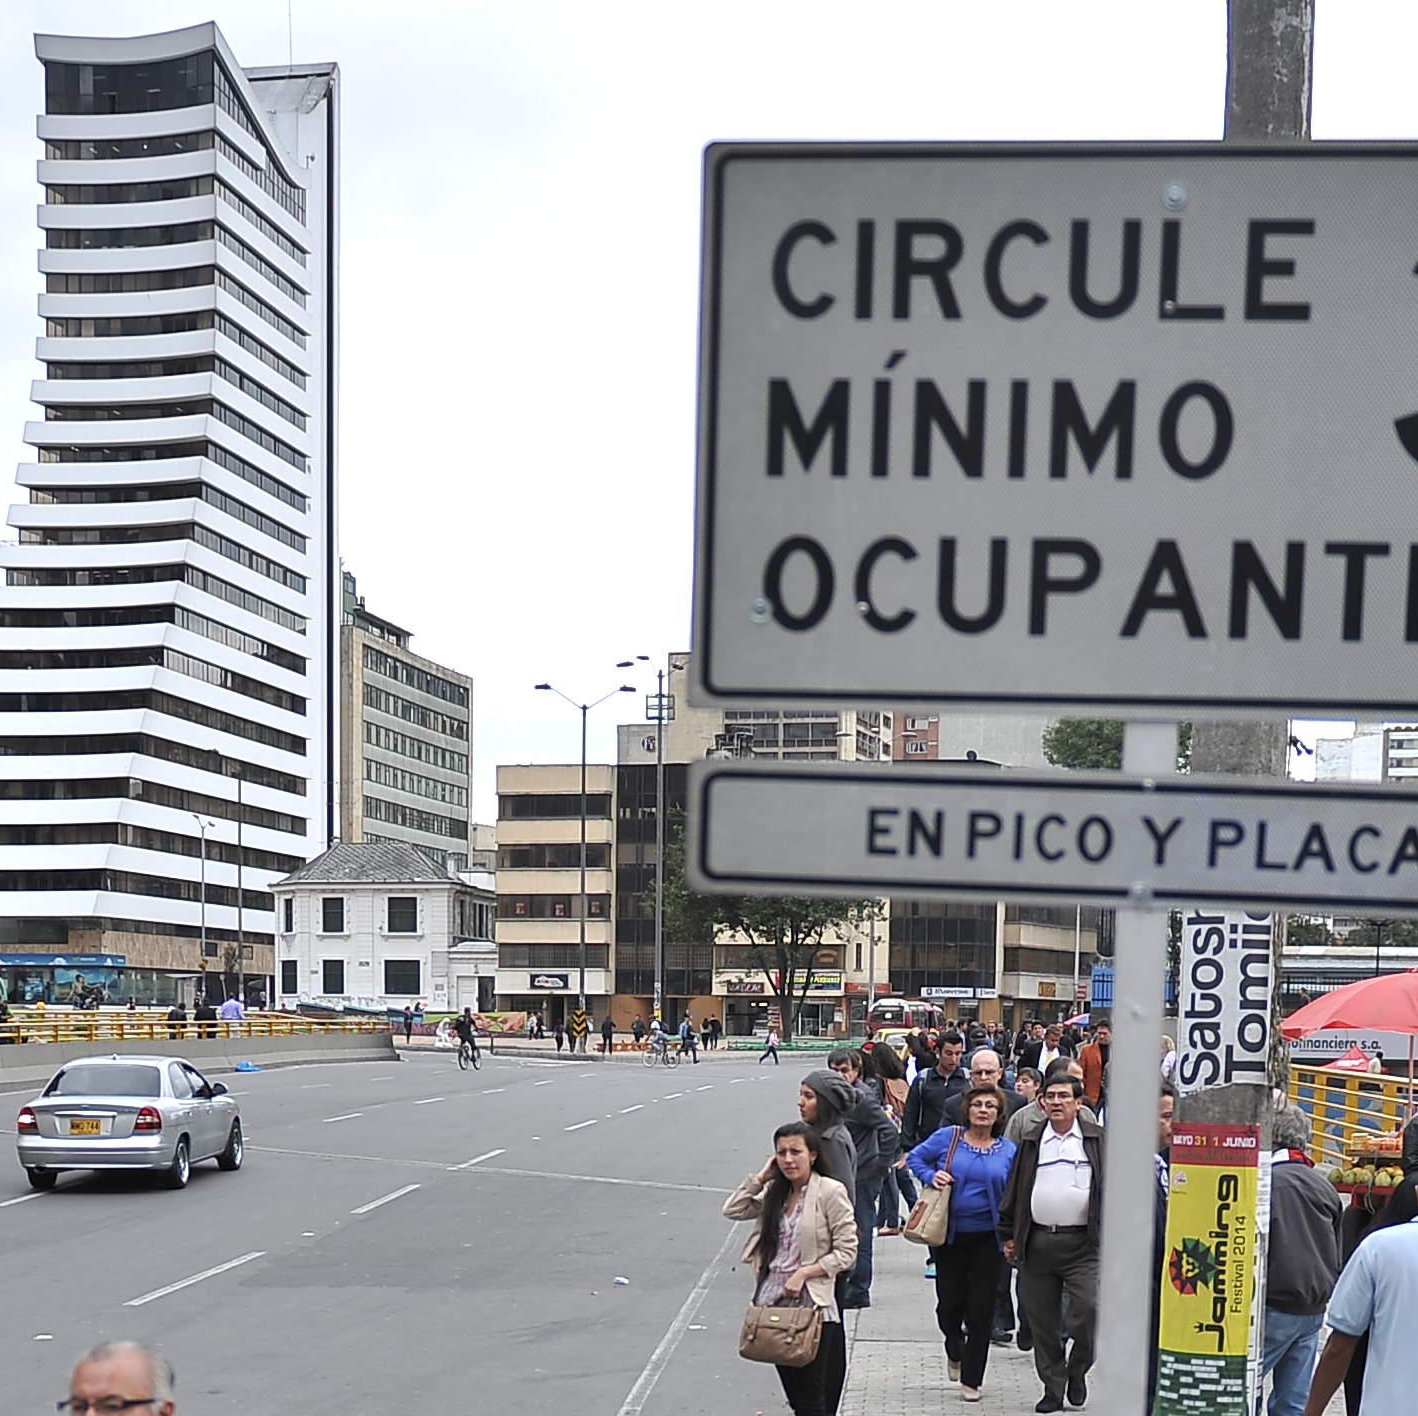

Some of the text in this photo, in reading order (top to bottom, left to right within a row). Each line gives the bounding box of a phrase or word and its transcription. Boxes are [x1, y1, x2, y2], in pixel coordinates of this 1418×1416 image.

[771, 219, 1316, 322] CIRCULE
[765, 350, 1235, 481] MÍNIMO
[866, 807, 944, 859] EN
[966, 811, 1114, 864] PICO
[1143, 817, 1183, 867] Y
[1194, 1135, 1207, 1147] 31
[1212, 1136, 1220, 1147] 1
[1222, 1136, 1257, 1149] JUNIO
[1230, 1215, 1247, 1314] Festival 2014
